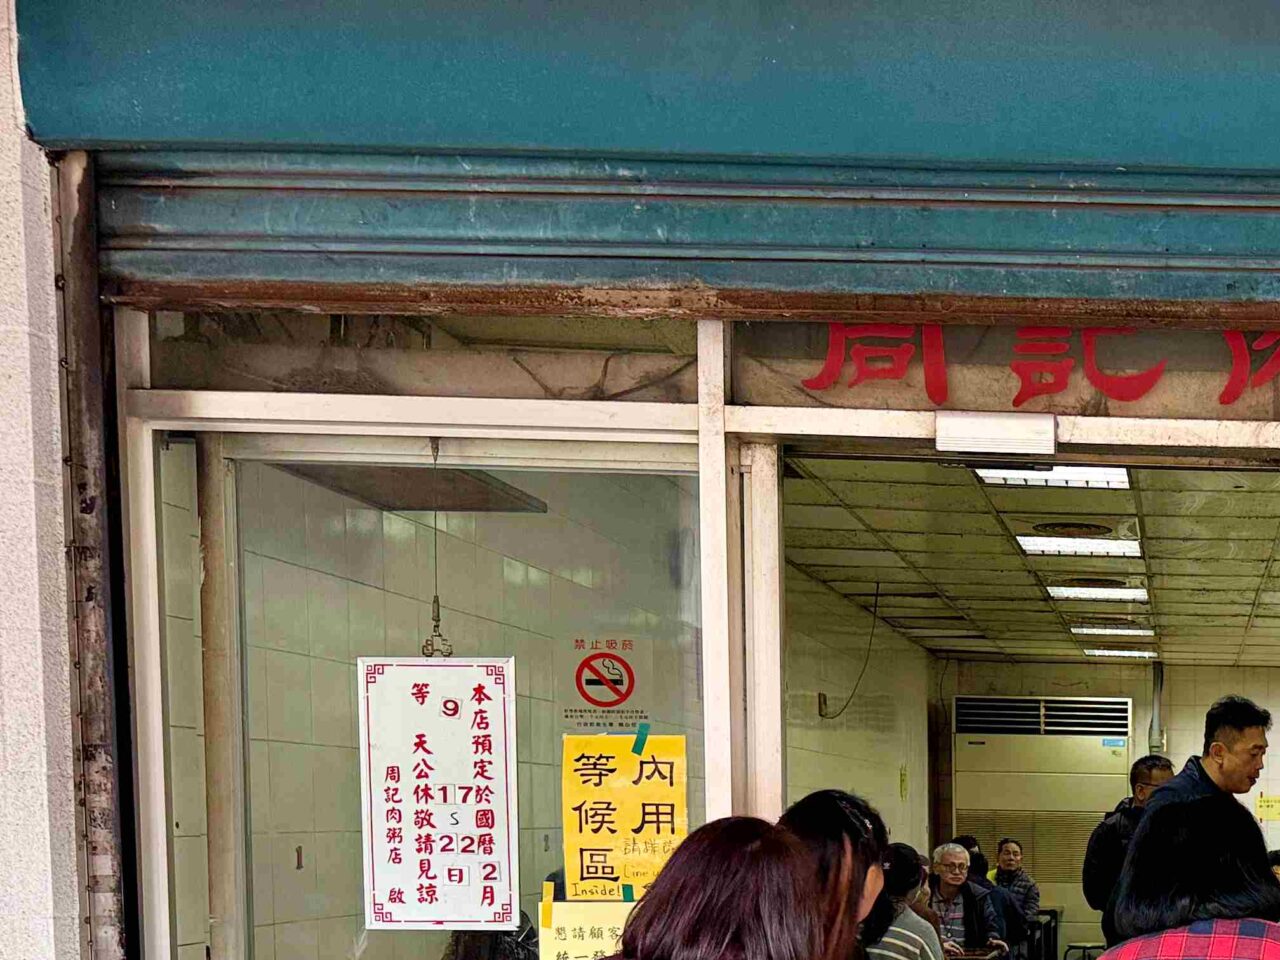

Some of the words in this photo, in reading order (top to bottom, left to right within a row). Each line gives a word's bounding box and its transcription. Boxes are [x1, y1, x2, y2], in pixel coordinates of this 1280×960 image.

[574, 639, 634, 651] 禁止吸菸
[572, 753, 620, 882] 等候區
